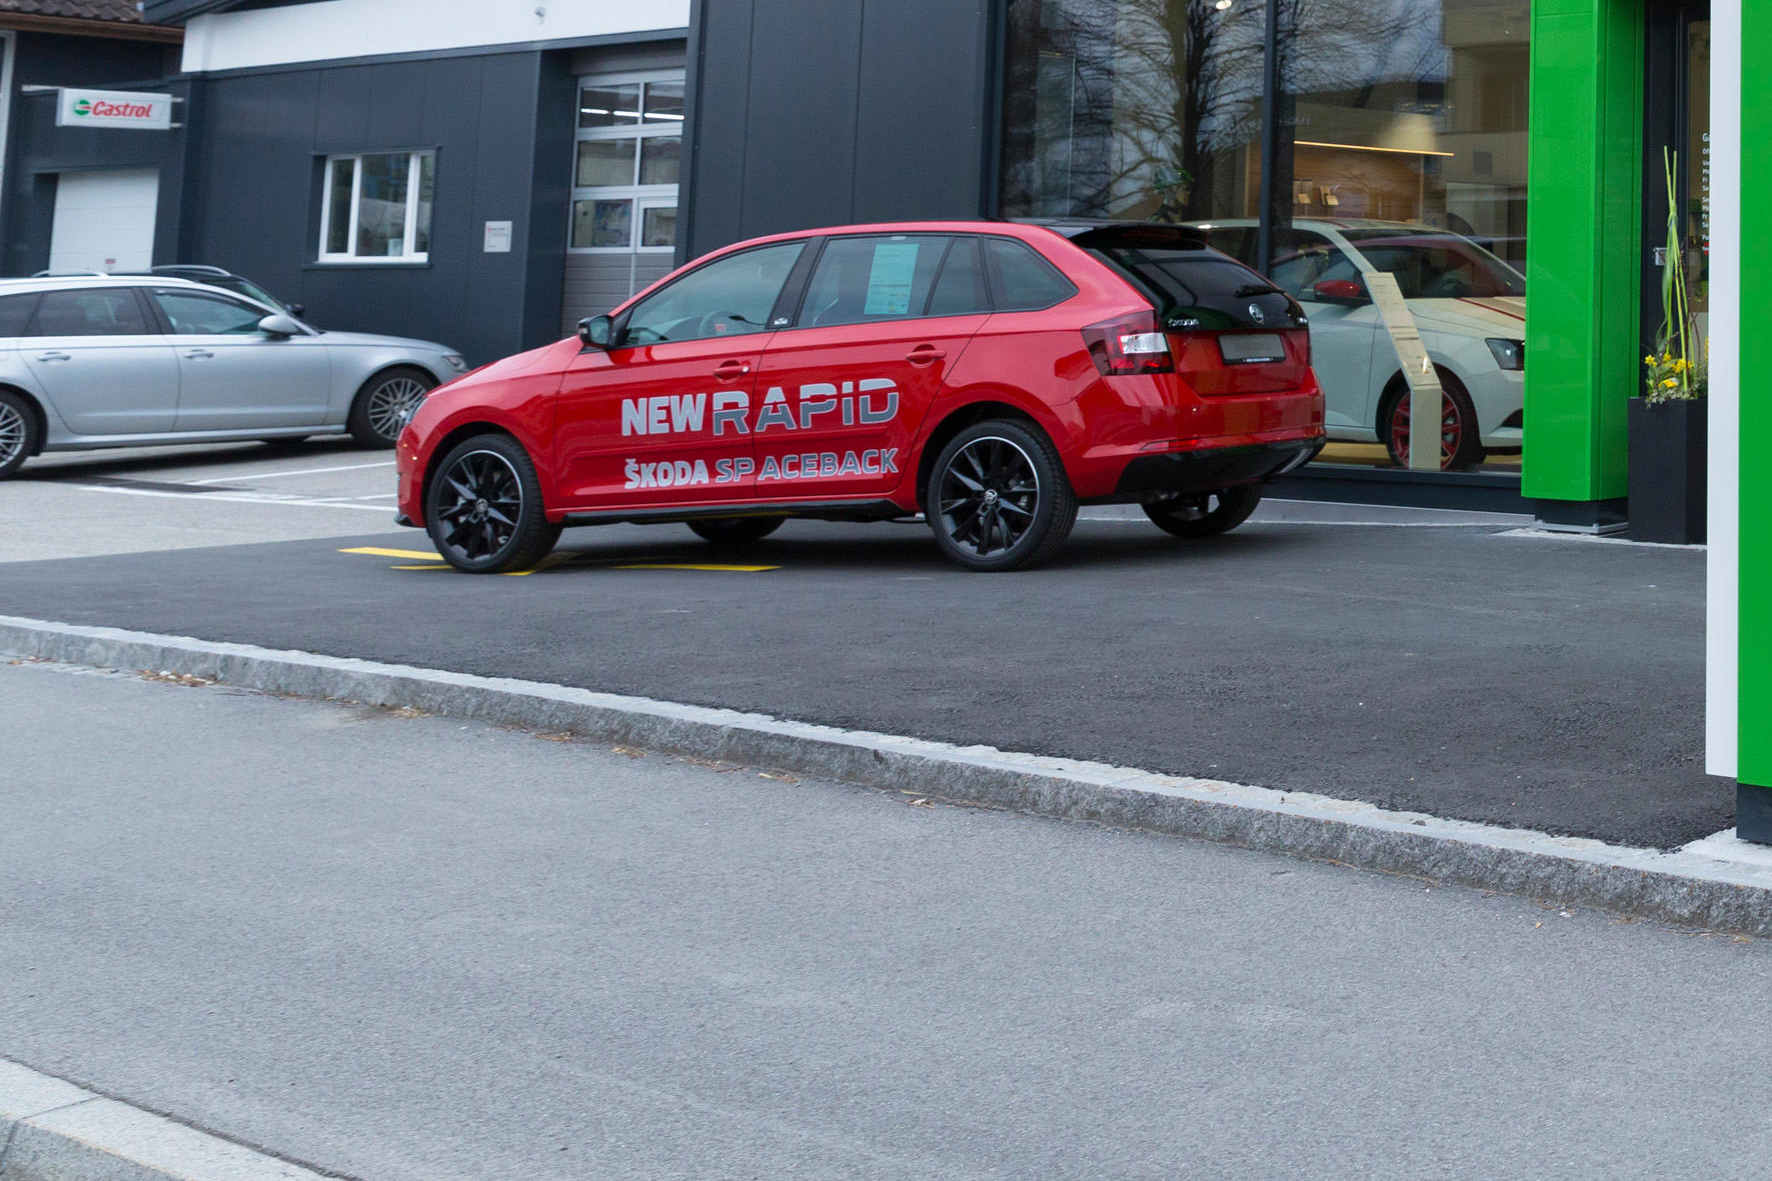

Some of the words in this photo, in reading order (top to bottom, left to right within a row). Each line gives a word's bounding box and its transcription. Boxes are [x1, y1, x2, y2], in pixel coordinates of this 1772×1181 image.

[92, 101, 153, 118] Castrol
[621, 393, 706, 436] NEW
[712, 377, 899, 436] RAPID
[624, 459, 709, 490] ŠKODA
